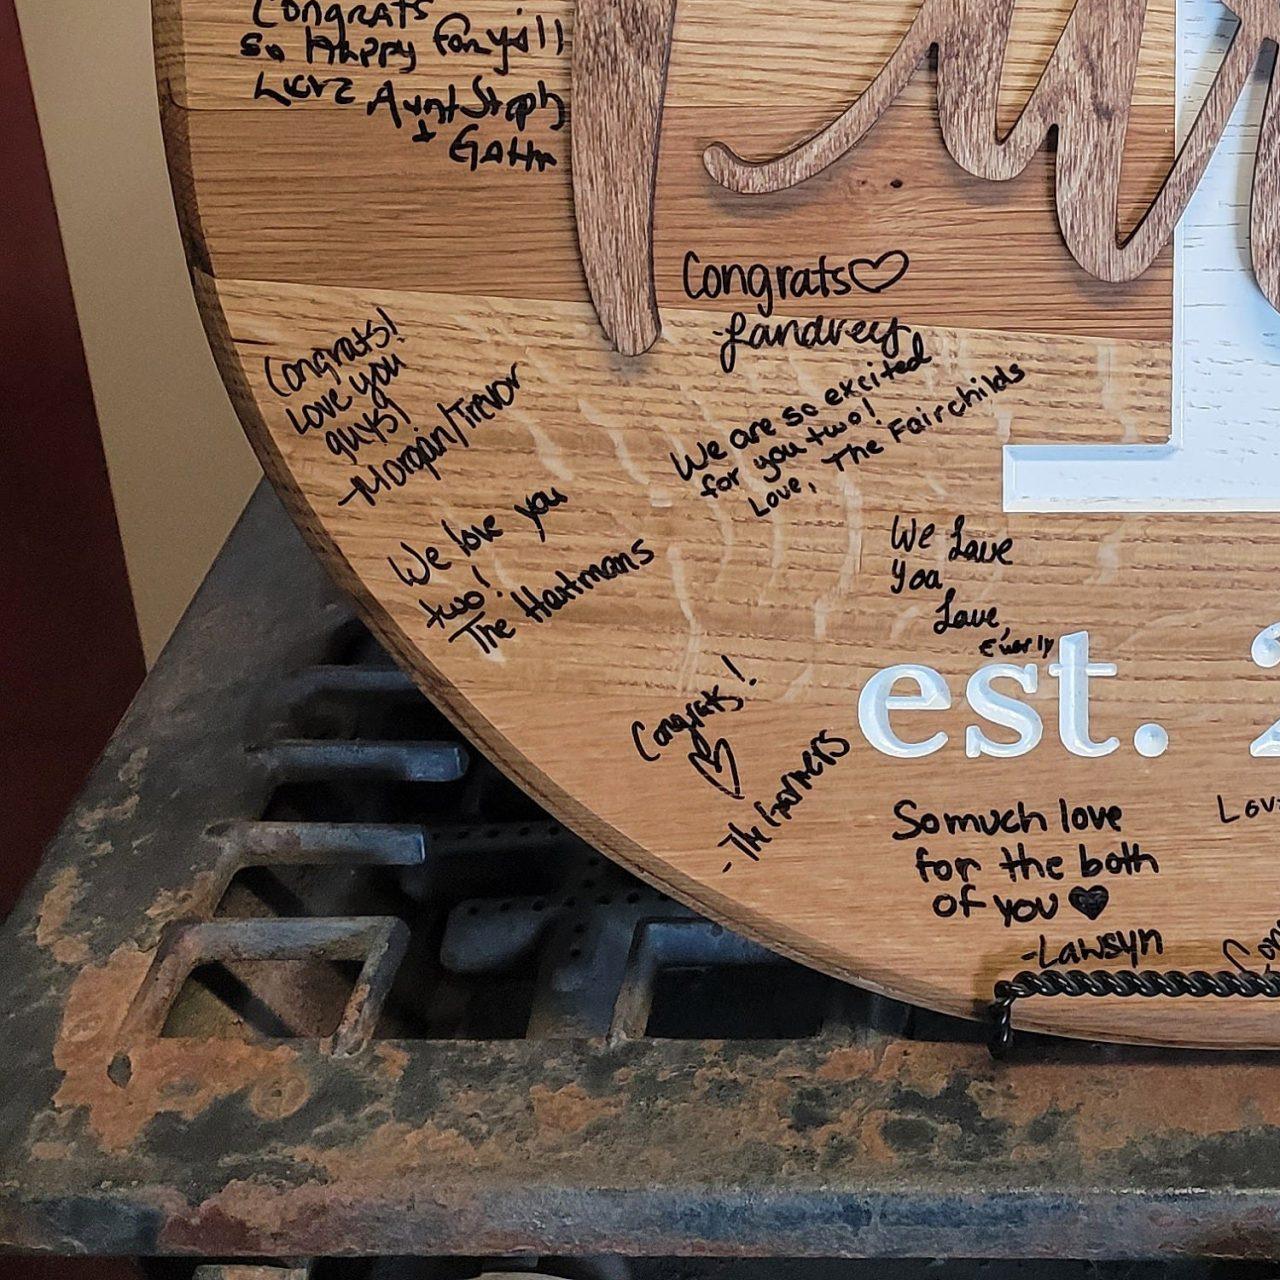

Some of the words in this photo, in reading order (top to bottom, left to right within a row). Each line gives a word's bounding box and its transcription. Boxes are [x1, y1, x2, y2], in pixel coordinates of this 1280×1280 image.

[683, 250, 850, 318] Congrats
[264, 307, 406, 397] Congrats!
[349, 354, 406, 410] you
[669, 439, 728, 481] We
[730, 417, 777, 451] are
[782, 402, 819, 427] so
[824, 332, 932, 406] excited
[821, 439, 884, 472] The
[888, 362, 1026, 443] Fairchilds
[700, 467, 740, 498] for
[753, 440, 807, 482] you
[806, 397, 881, 446] two!
[387, 542, 452, 587] We
[441, 515, 504, 557] love
[514, 487, 568, 543] you
[891, 515, 935, 552] We
[419, 565, 503, 629] two!
[449, 611, 516, 654] The
[857, 629, 1169, 759] est.
[1059, 797, 1123, 833] love
[915, 846, 982, 883] for
[999, 842, 1064, 882] the
[1079, 841, 1159, 878] both
[932, 883, 987, 918] of
[993, 893, 1059, 928] you
